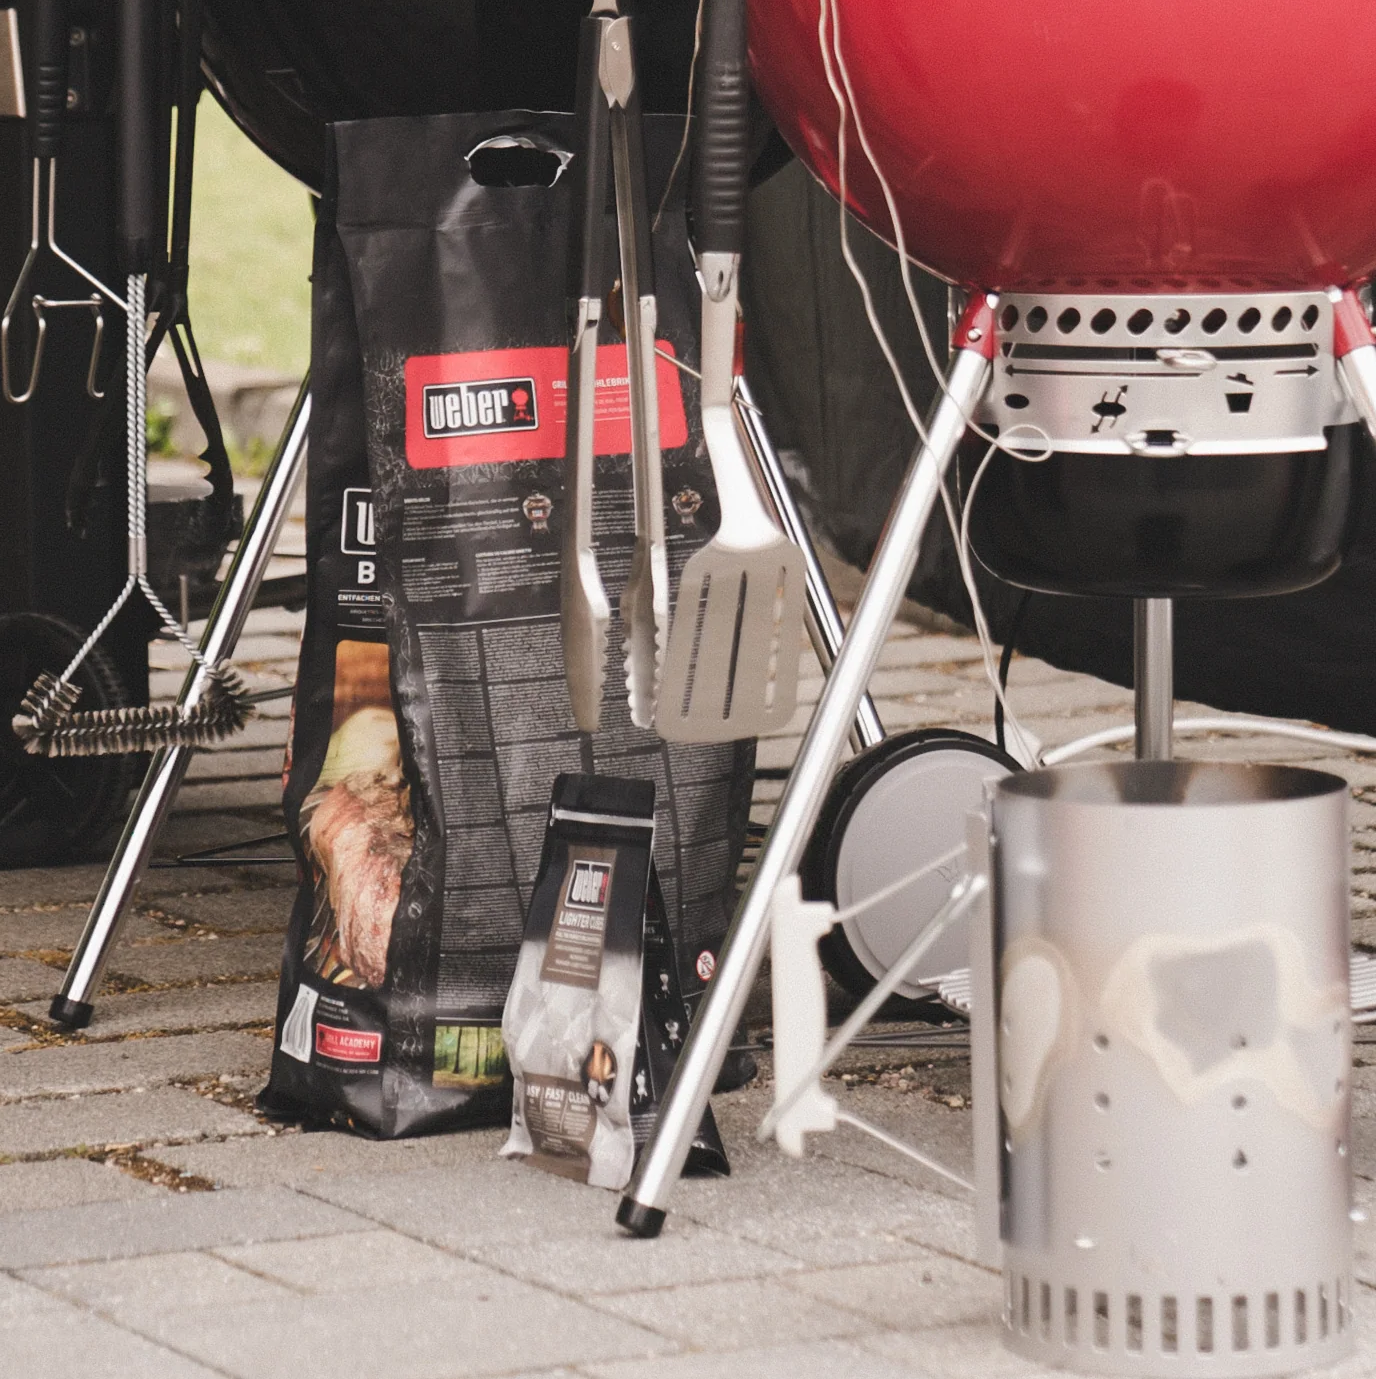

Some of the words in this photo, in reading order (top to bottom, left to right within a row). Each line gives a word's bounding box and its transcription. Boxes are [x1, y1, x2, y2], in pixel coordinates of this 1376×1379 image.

[428, 383, 509, 430] weber
[339, 1035, 376, 1049] ACADEMY
[544, 1087, 565, 1102] FAST
